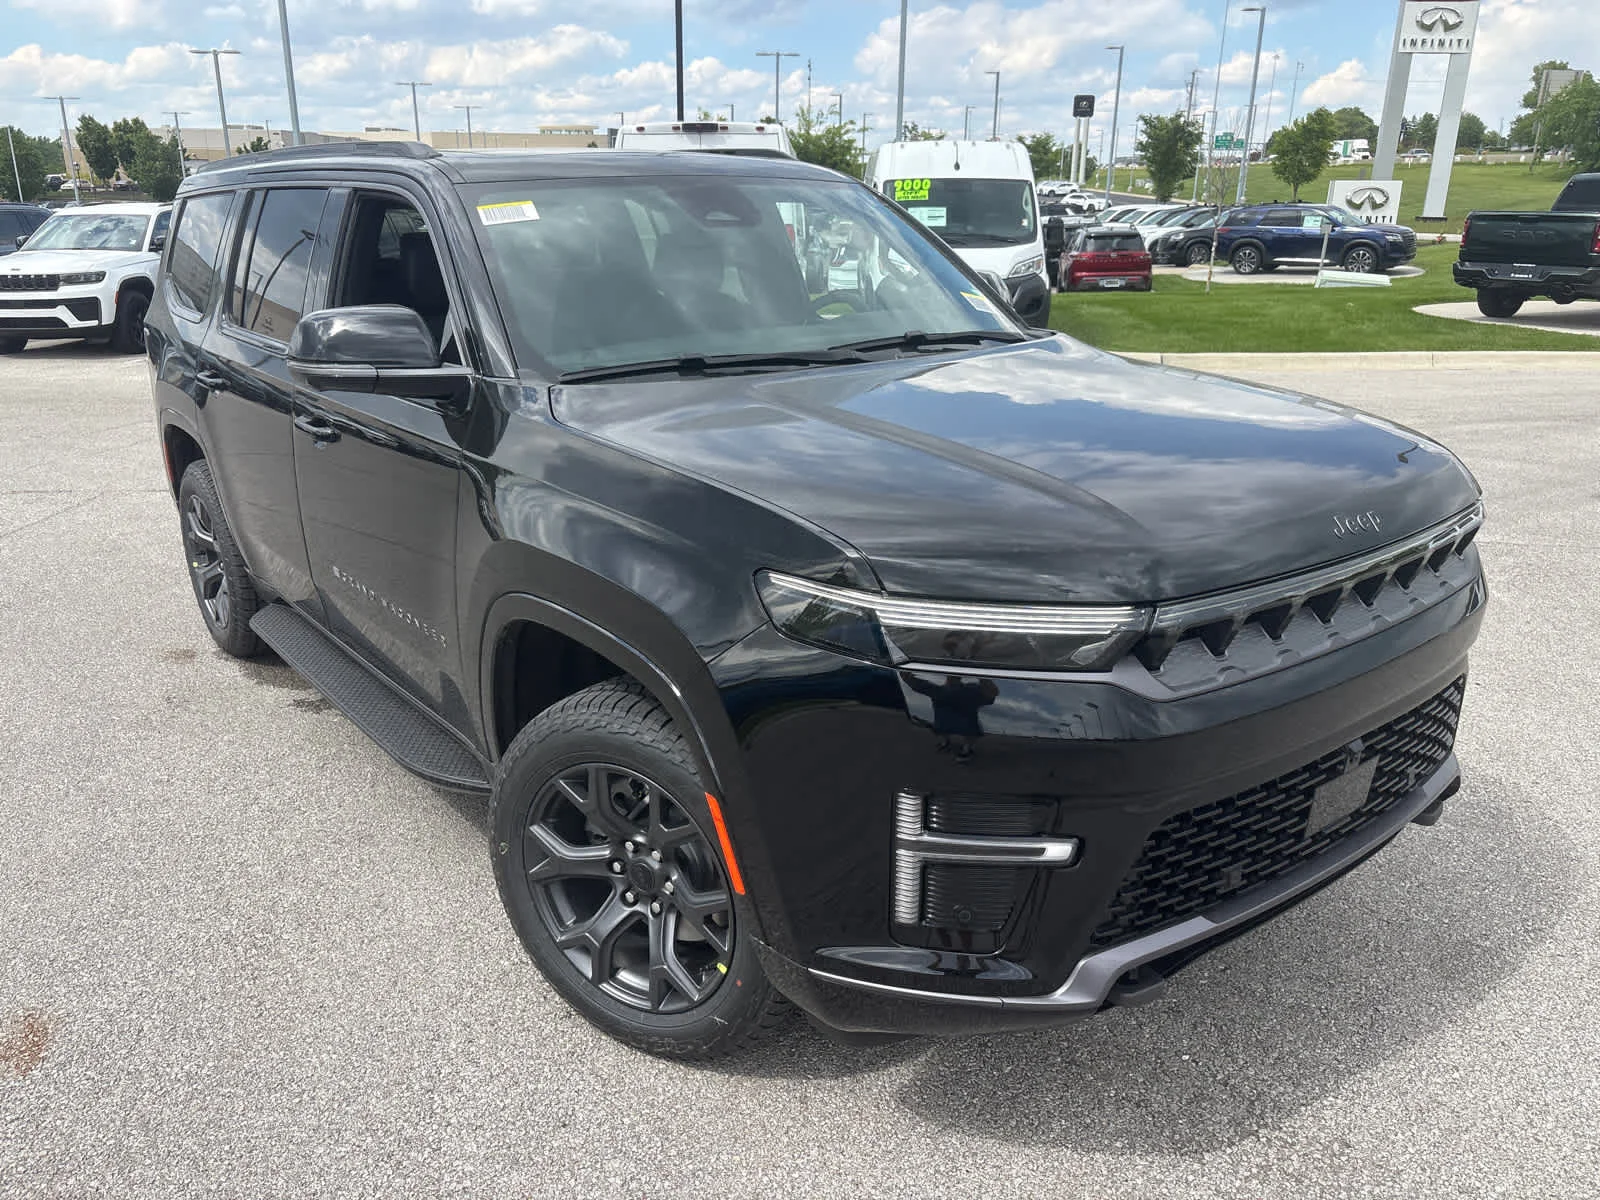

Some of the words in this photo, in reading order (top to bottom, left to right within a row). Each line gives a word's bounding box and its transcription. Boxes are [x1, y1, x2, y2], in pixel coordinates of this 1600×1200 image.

[1402, 38, 1470, 48] INFINITI
[894, 179, 931, 191] 9000
[1333, 510, 1380, 539] Jeep
